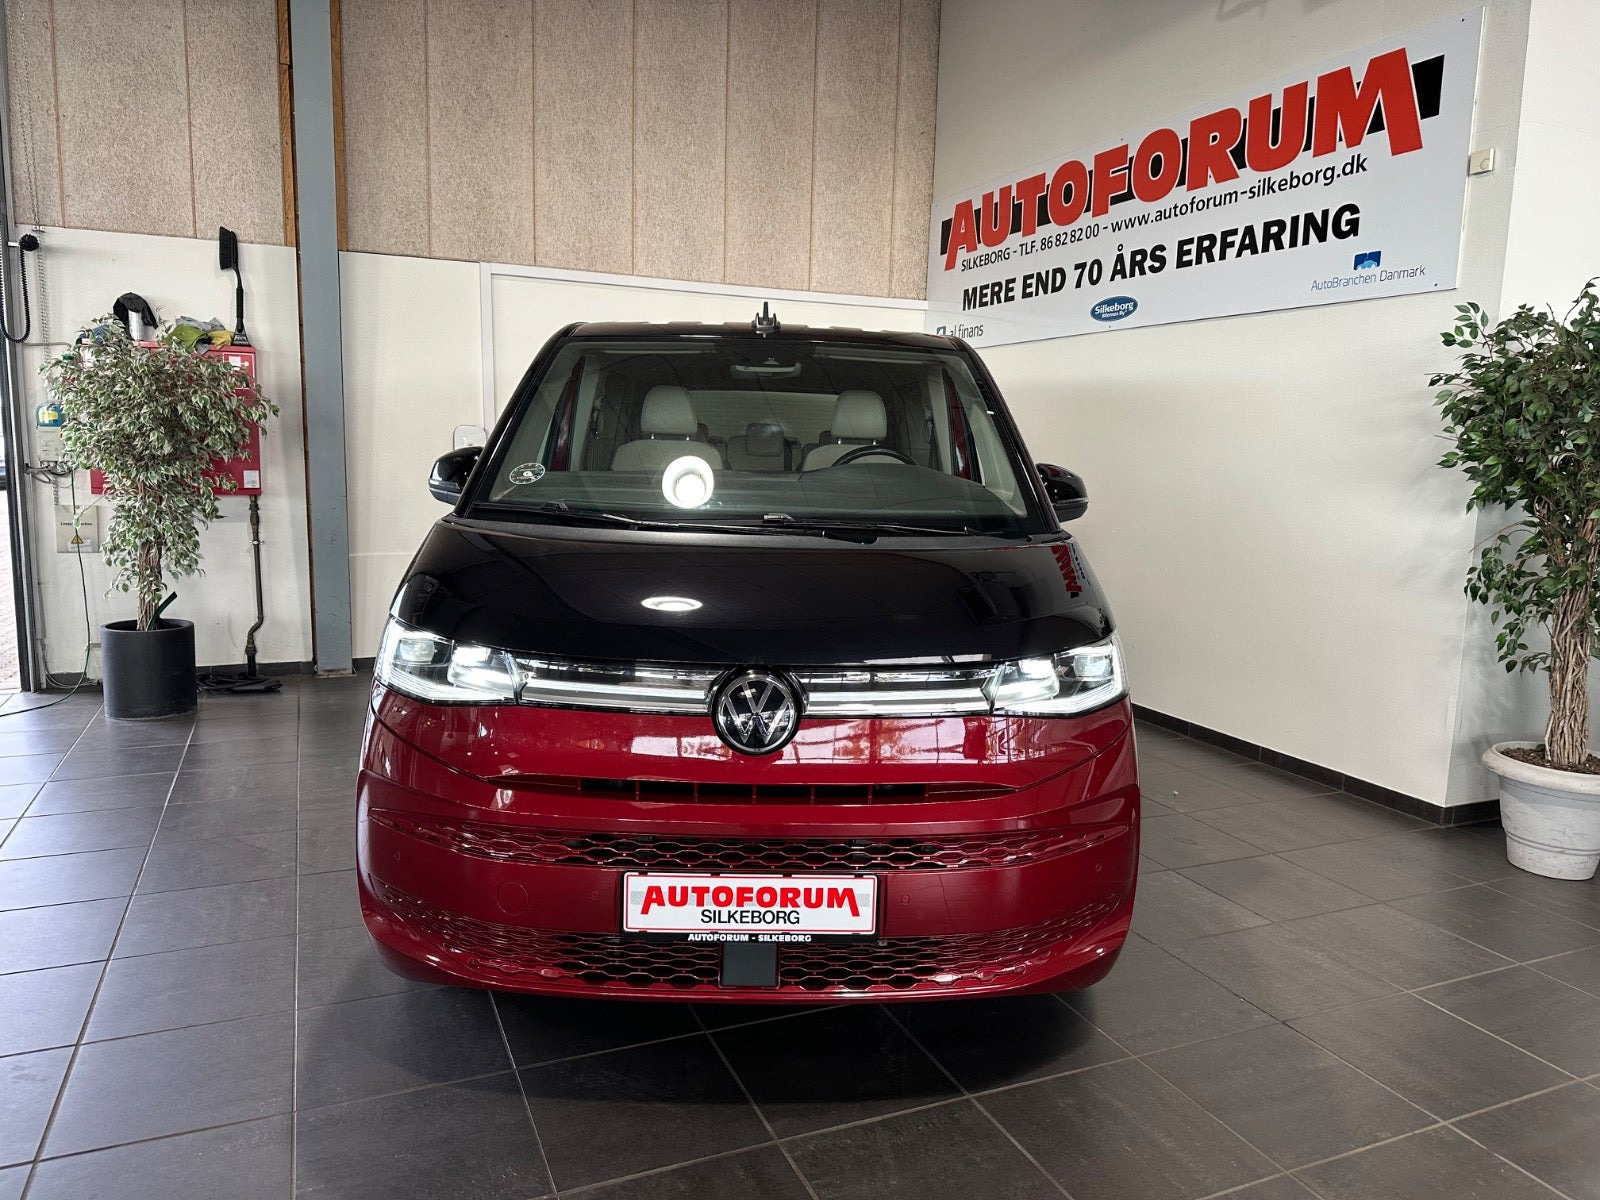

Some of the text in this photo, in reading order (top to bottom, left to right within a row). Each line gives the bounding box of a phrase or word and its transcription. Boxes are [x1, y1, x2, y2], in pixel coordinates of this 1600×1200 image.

[944, 47, 1423, 270] AUTOFORUM
[961, 247, 1011, 272] SILKEBORG
[1019, 240, 1039, 258] TLF.
[1111, 153, 1368, 233] www.autoforum-silkeborg.dk
[962, 203, 1361, 311] MERE END 70 ÅRS ERFARING
[1311, 265, 1426, 291] AutoBranchen Danmark
[1094, 301, 1134, 315] Silkeborg
[958, 323, 984, 339] finans
[640, 885, 861, 917] AUTOFORUM
[700, 909, 800, 925] SILKEBORG
[688, 933, 749, 942] AUTOFORUM
[758, 934, 812, 943] SILKEBORG
